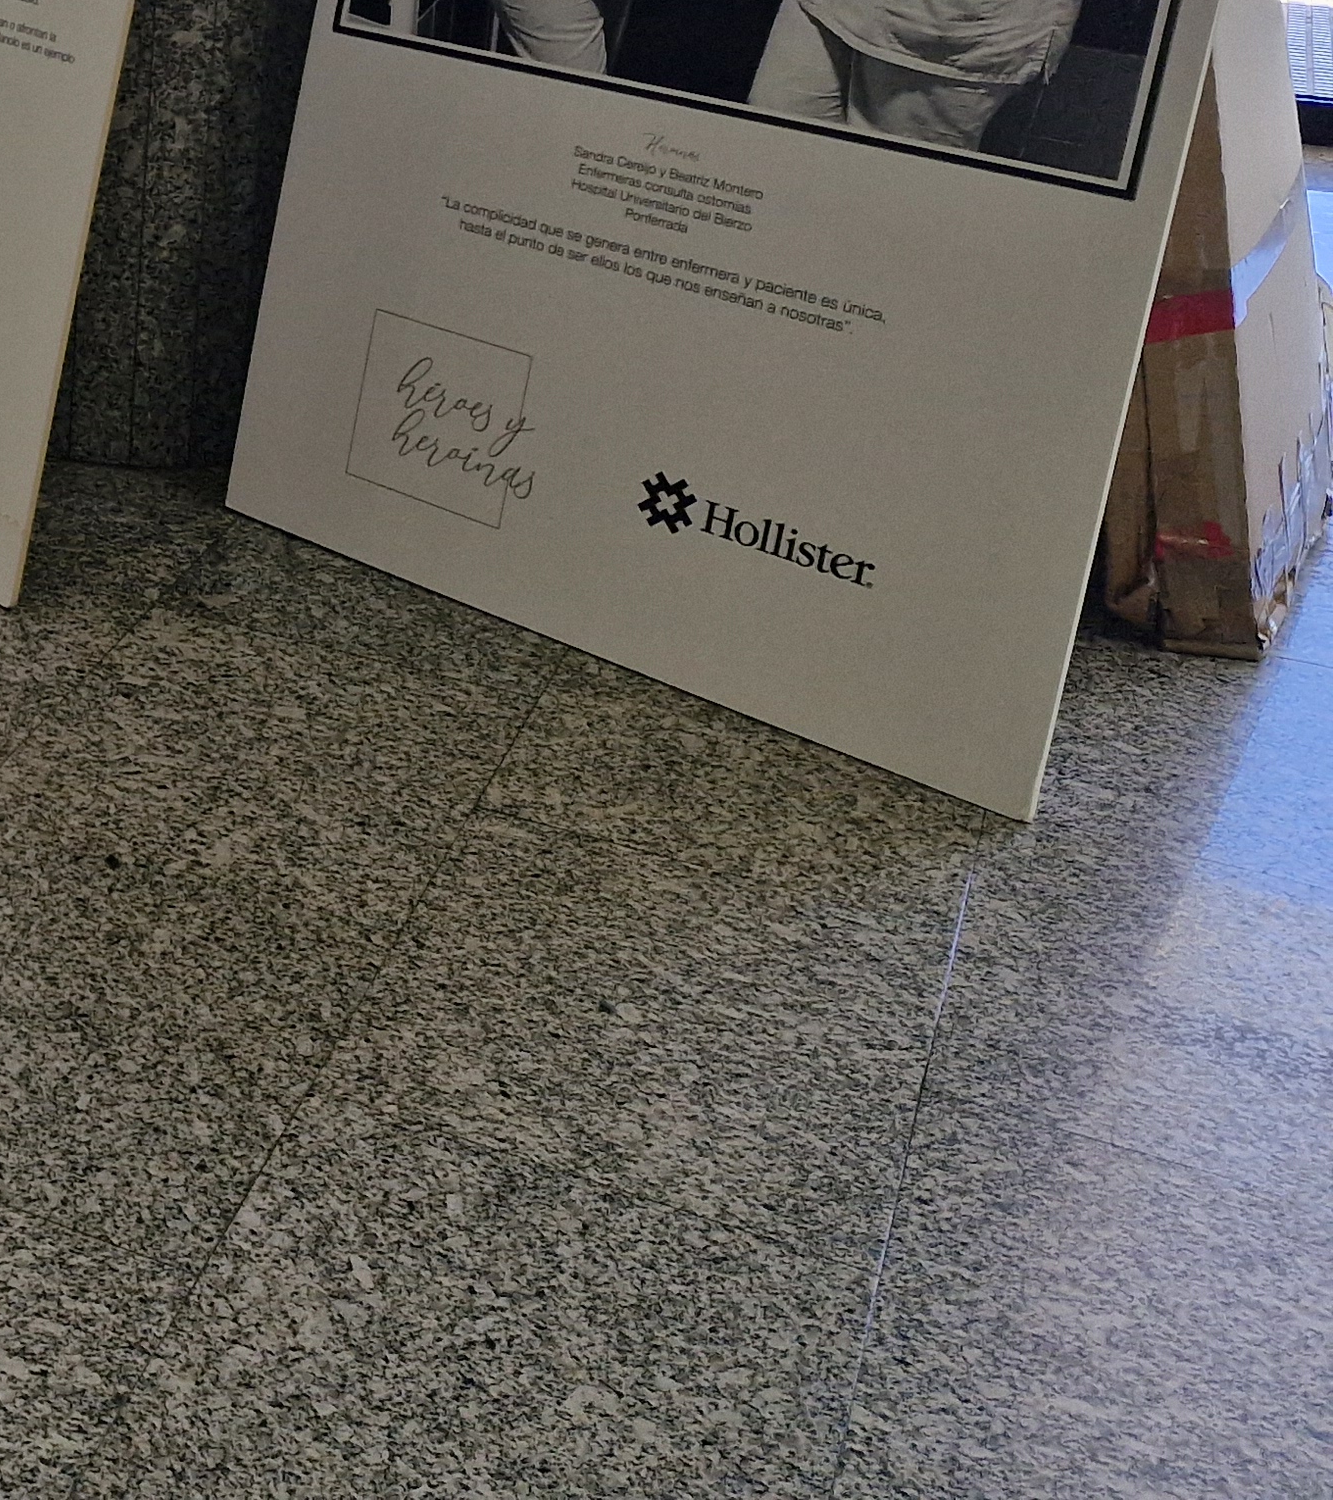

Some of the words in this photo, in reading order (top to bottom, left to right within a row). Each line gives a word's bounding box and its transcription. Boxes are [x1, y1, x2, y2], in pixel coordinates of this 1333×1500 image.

[573, 144, 613, 165] Sandra
[659, 166, 666, 180] y
[669, 167, 709, 189] Beatriz
[712, 177, 763, 201] Montero
[577, 162, 641, 189] Enfermeras
[645, 178, 693, 202] consulta
[571, 176, 617, 201] Hospital
[619, 188, 689, 218] Universitario
[692, 205, 711, 222] del
[713, 211, 753, 233] Bierzo
[625, 206, 689, 234] Ponferrada
[459, 217, 492, 238] hasta
[495, 226, 507, 242] el
[508, 229, 545, 255] punto
[547, 240, 565, 258] de
[567, 247, 587, 264] ser
[590, 251, 621, 273] ellos
[624, 261, 642, 279] los
[646, 269, 671, 288] que
[675, 277, 701, 295] nos
[704, 282, 765, 312] enseñan
[767, 302, 777, 315] a
[463, 200, 537, 233] complicidad
[539, 221, 563, 240] que
[567, 228, 583, 243] se
[586, 233, 629, 258] genera
[633, 244, 667, 266] entre
[671, 253, 740, 286] enfermera
[743, 275, 752, 291] y
[755, 276, 819, 309] paciente
[820, 295, 837, 310] es
[488, 416, 535, 457] y
